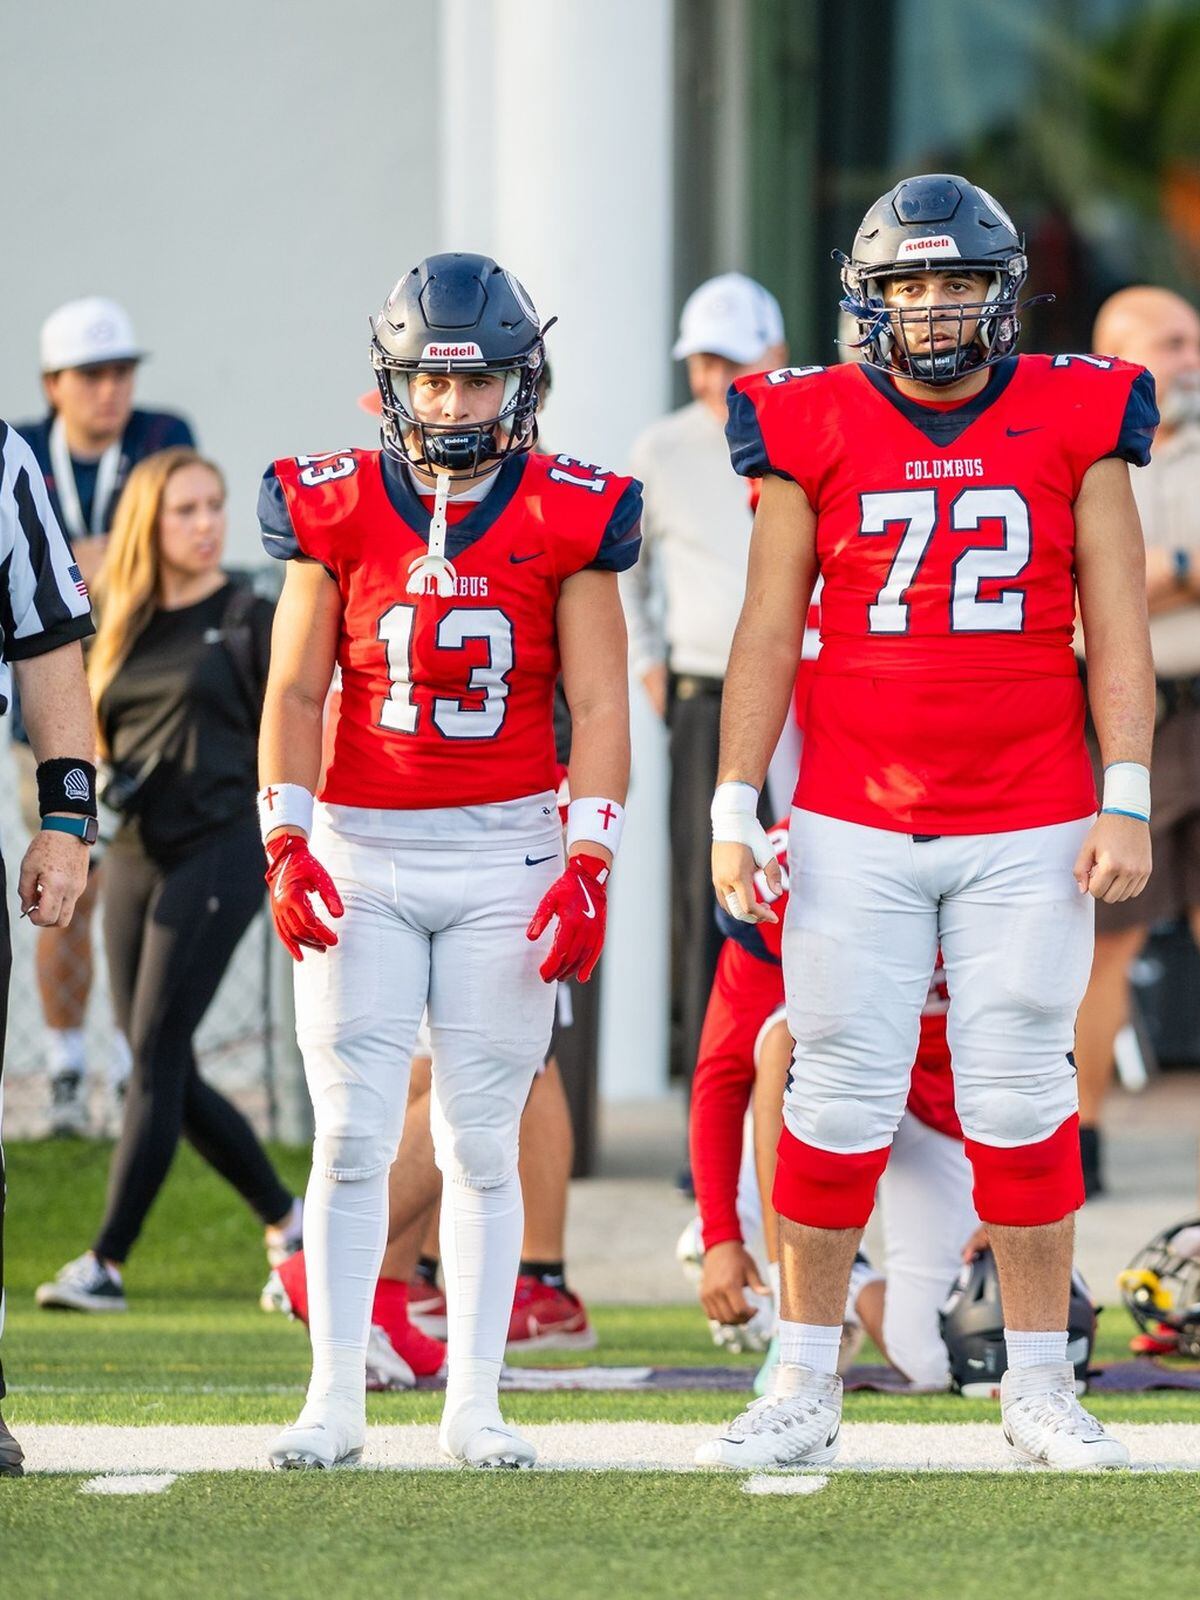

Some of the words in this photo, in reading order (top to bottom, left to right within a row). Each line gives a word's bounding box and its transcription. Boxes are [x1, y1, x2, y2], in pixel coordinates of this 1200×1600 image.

[429, 345, 475, 356] Riddell
[444, 437, 469, 445] Riddell
[297, 447, 357, 487] 13
[905, 458, 984, 480] COLUMBUS
[859, 486, 1032, 635] 72
[376, 602, 517, 741] 13
